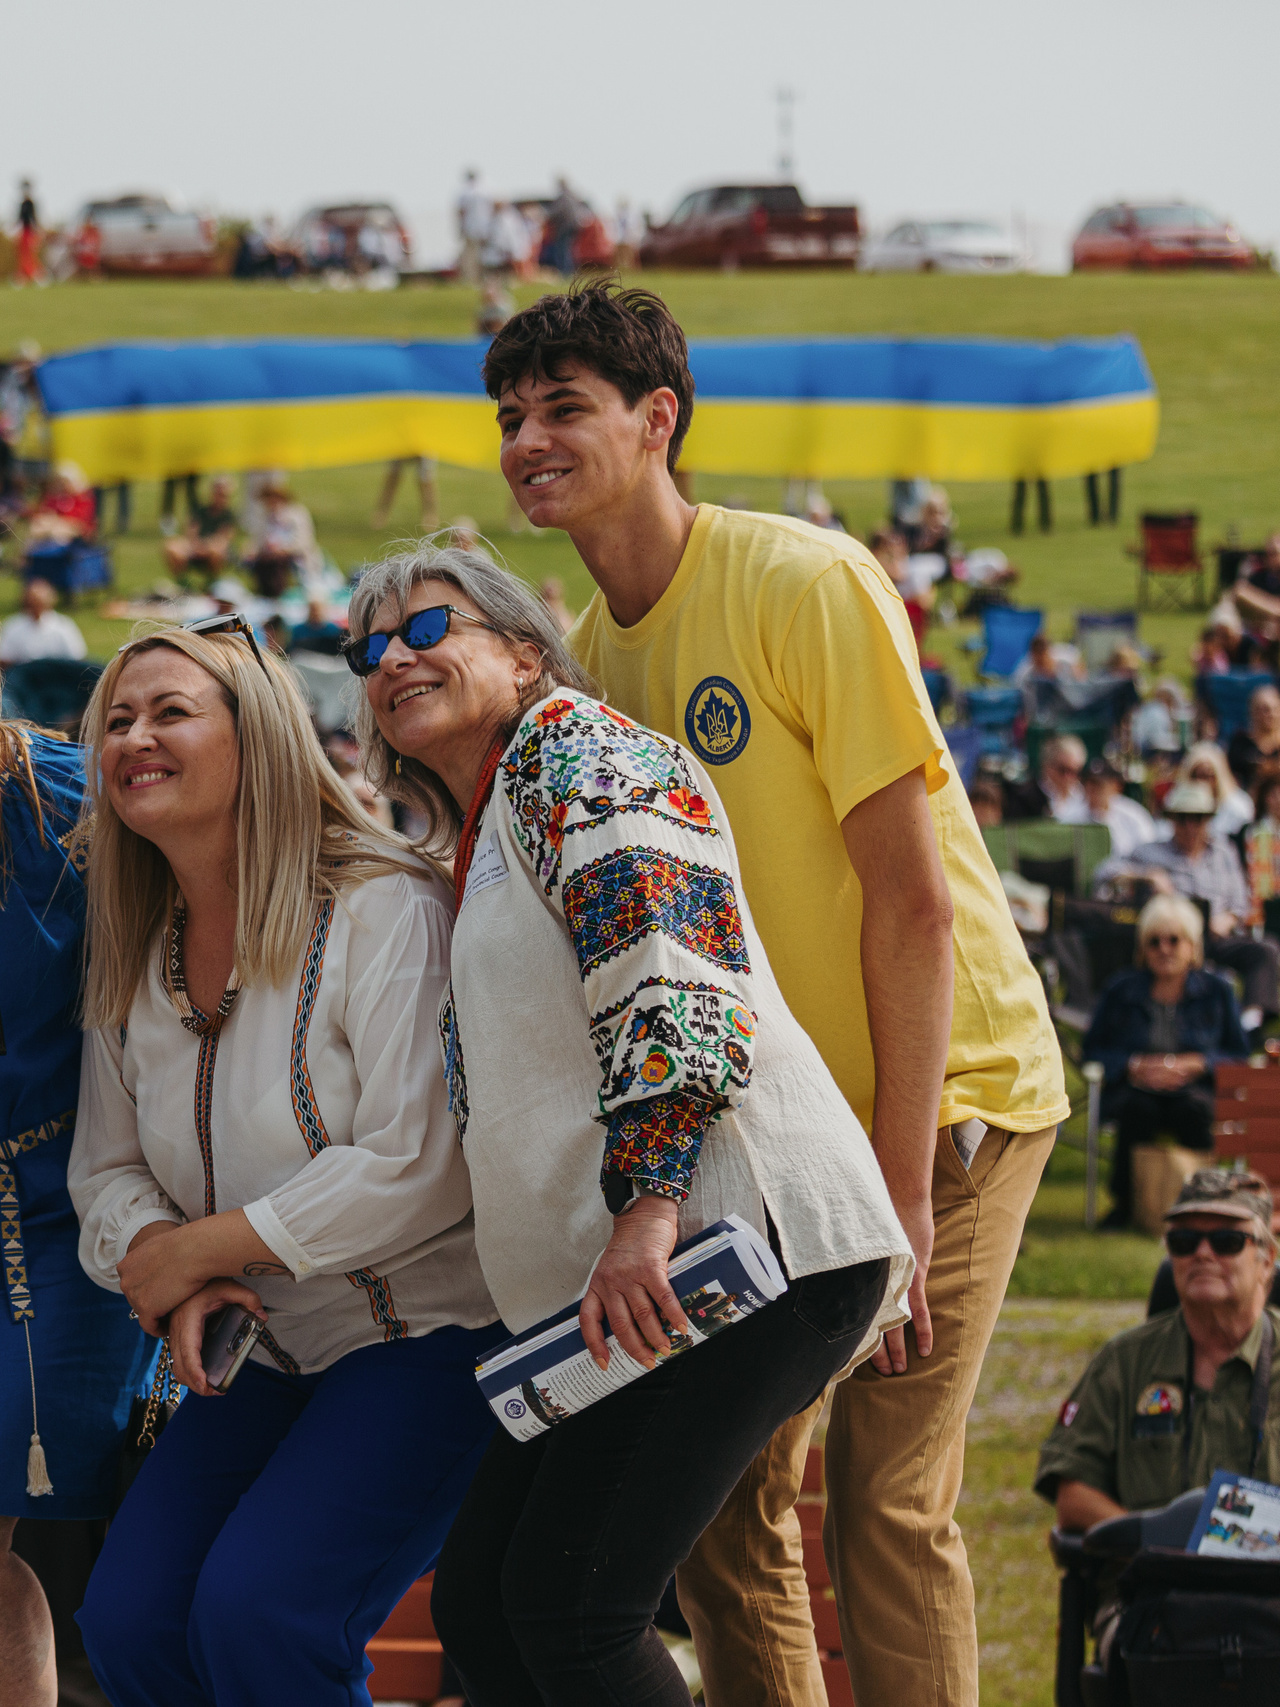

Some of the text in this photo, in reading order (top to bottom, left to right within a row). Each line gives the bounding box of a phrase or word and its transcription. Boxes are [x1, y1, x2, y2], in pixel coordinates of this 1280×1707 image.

[688, 679, 742, 718] Ukrainian Canadian Congress
[707, 739, 735, 752] ALBERTA
